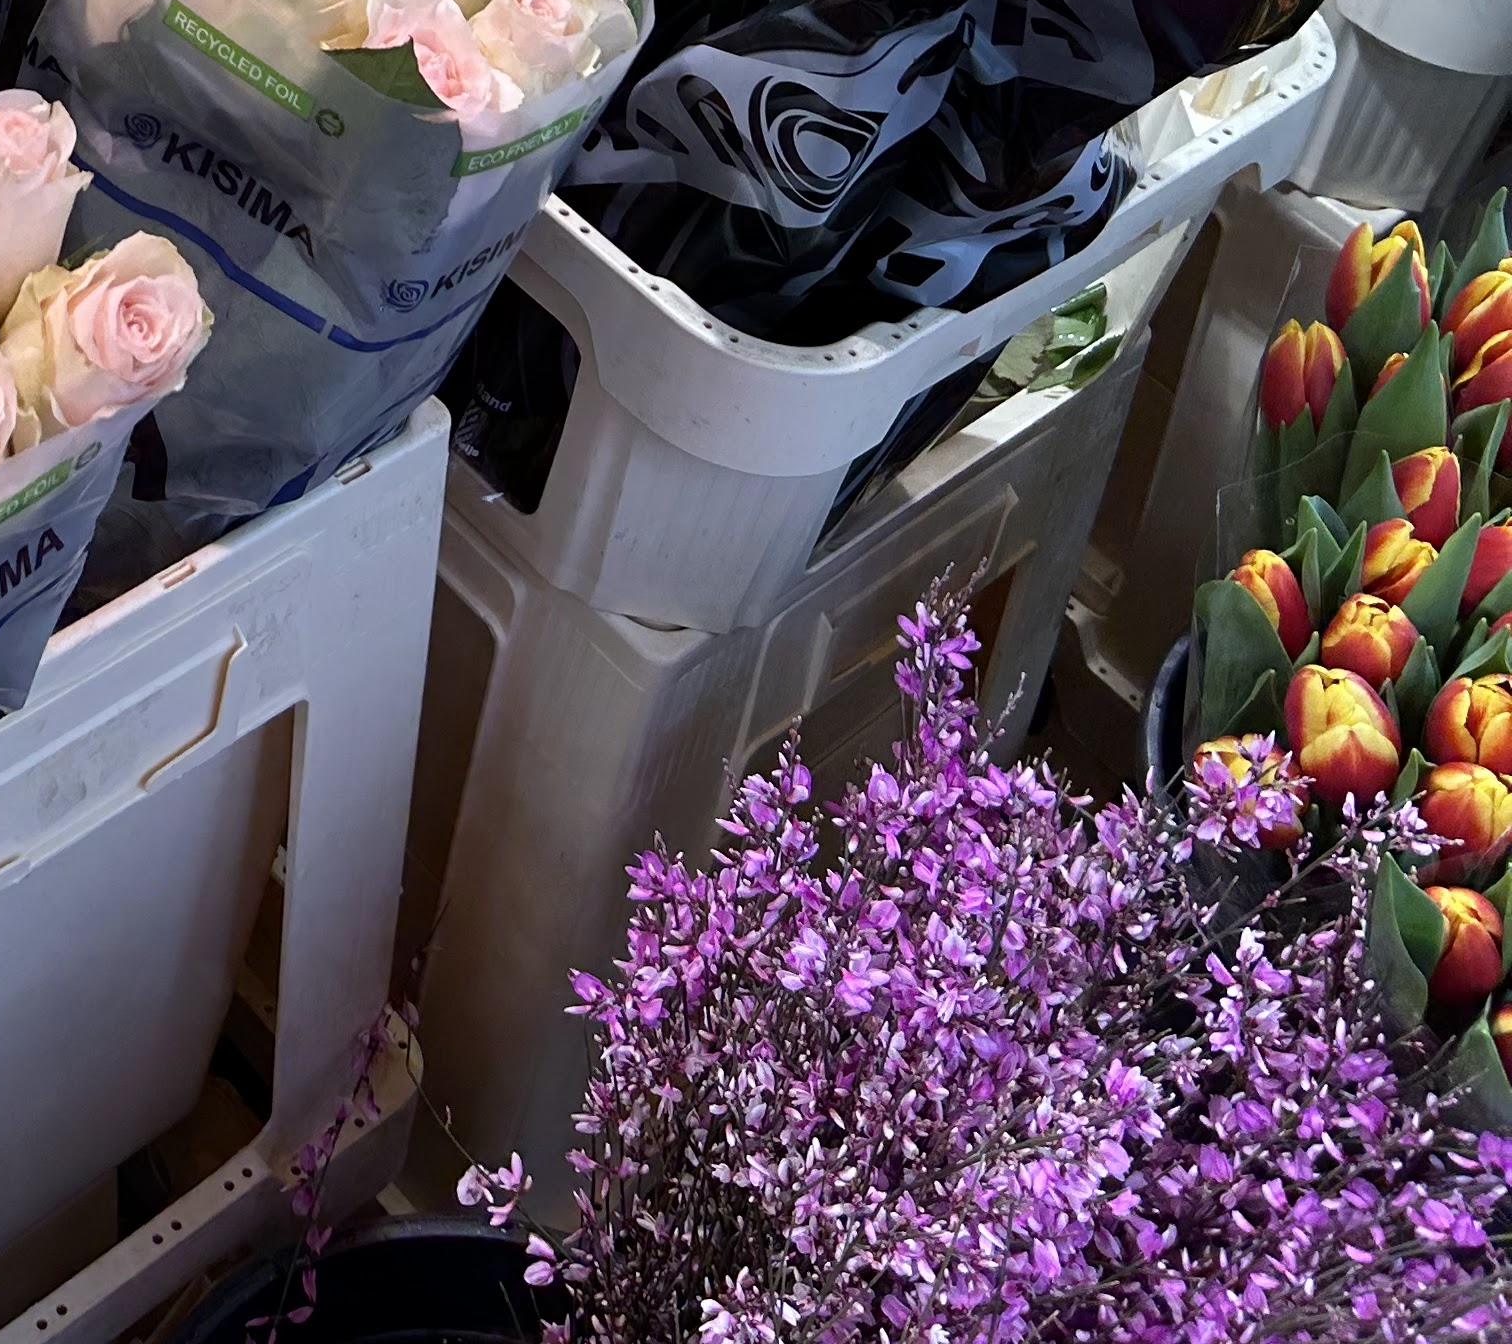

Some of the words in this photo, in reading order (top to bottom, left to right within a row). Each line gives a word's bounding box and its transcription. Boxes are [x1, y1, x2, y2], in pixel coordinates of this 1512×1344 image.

[174, 9, 263, 82] RECYCLED
[264, 75, 302, 110] FOIL
[467, 148, 504, 171] ECO
[504, 119, 572, 160] FRIENDLY
[161, 132, 315, 260] KISIMA
[21, 471, 63, 503] FOIL
